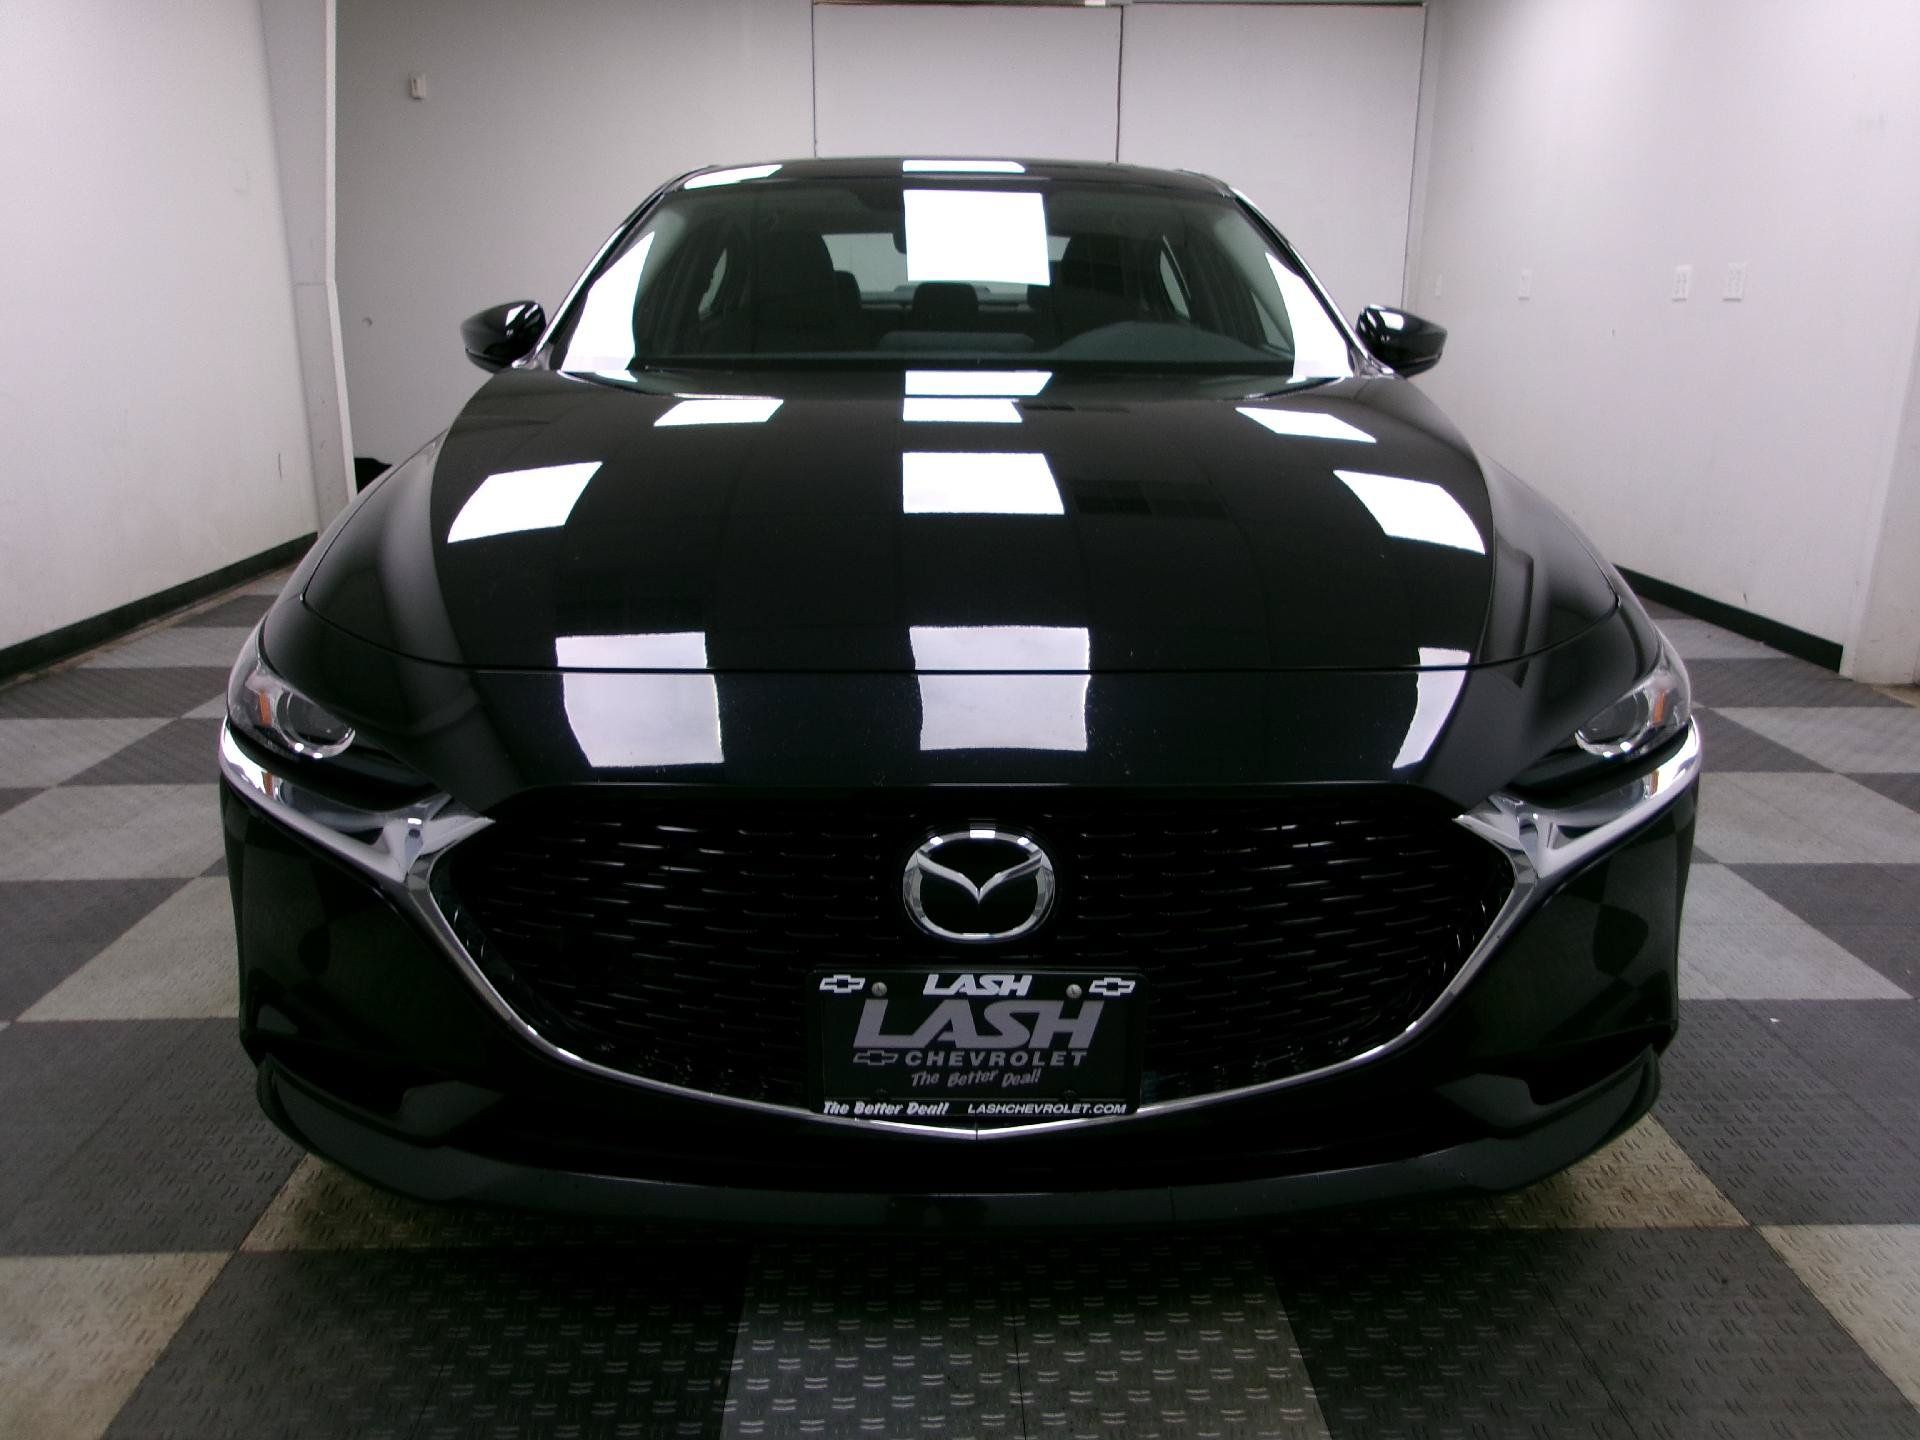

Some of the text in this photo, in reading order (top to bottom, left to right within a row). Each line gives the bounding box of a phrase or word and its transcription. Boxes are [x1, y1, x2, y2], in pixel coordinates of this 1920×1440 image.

[923, 974, 1032, 996] LASH
[853, 999, 1105, 1048] LASH
[905, 1051, 1087, 1066] CHEVROLET
[911, 1068, 1041, 1087] The Better Deal!
[823, 1102, 849, 1115] The
[854, 1102, 903, 1115] Better
[967, 1103, 1126, 1115] LASHCHEVROLET.COM
